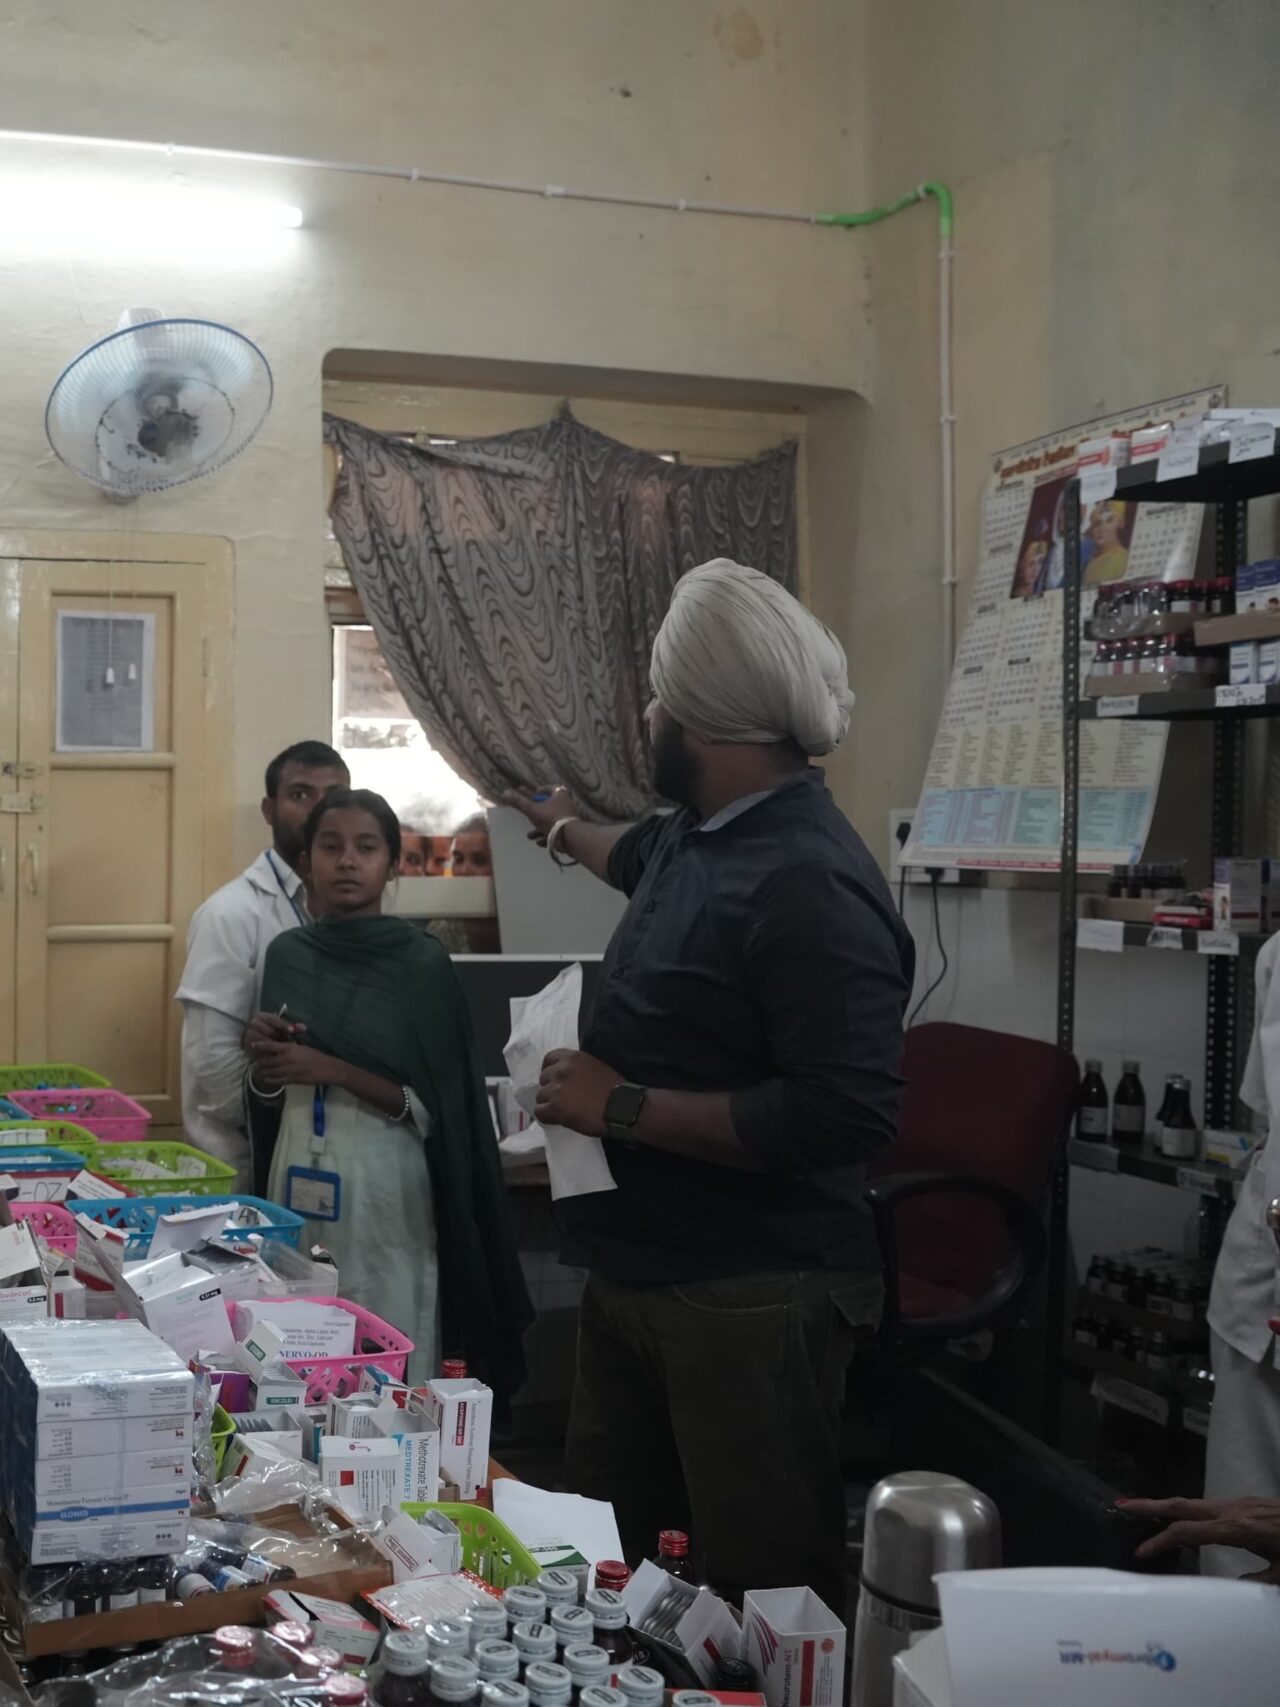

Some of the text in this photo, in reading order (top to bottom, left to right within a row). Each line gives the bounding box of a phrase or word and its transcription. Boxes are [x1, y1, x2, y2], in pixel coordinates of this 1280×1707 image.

[403, 1439, 413, 1495] MEDTREXATE
[417, 1438, 430, 1485] Methotrexate
[60, 1510, 89, 1519] ELOMED
